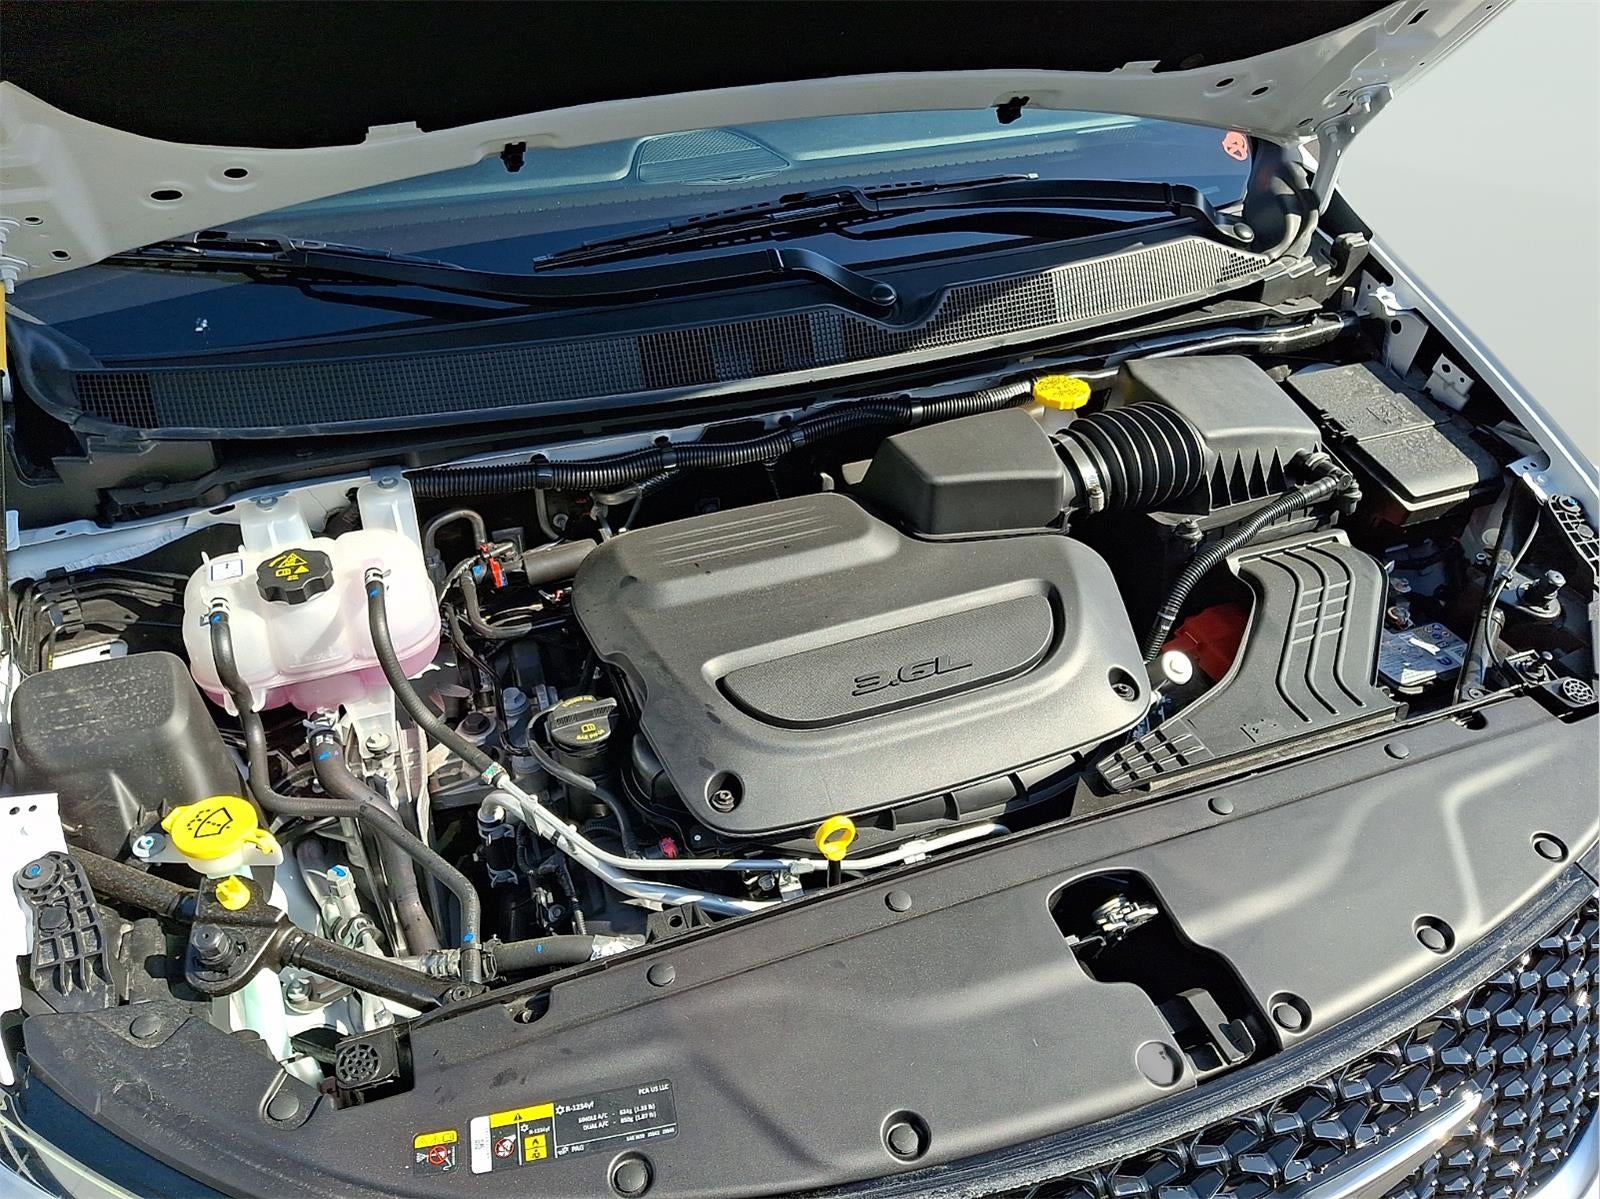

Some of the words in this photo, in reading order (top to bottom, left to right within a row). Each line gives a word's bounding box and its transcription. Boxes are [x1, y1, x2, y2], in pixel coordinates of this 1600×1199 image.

[851, 655, 973, 697] 3.6L
[638, 1087, 650, 1095] FCA
[650, 1085, 659, 1093] US
[659, 1083, 669, 1091] LLC
[565, 1100, 594, 1112] R-1234yf
[578, 1114, 597, 1123] SINGLE
[597, 1112, 609, 1120] A/C
[582, 1122, 598, 1131] DUAL
[598, 1120, 609, 1128] A/C
